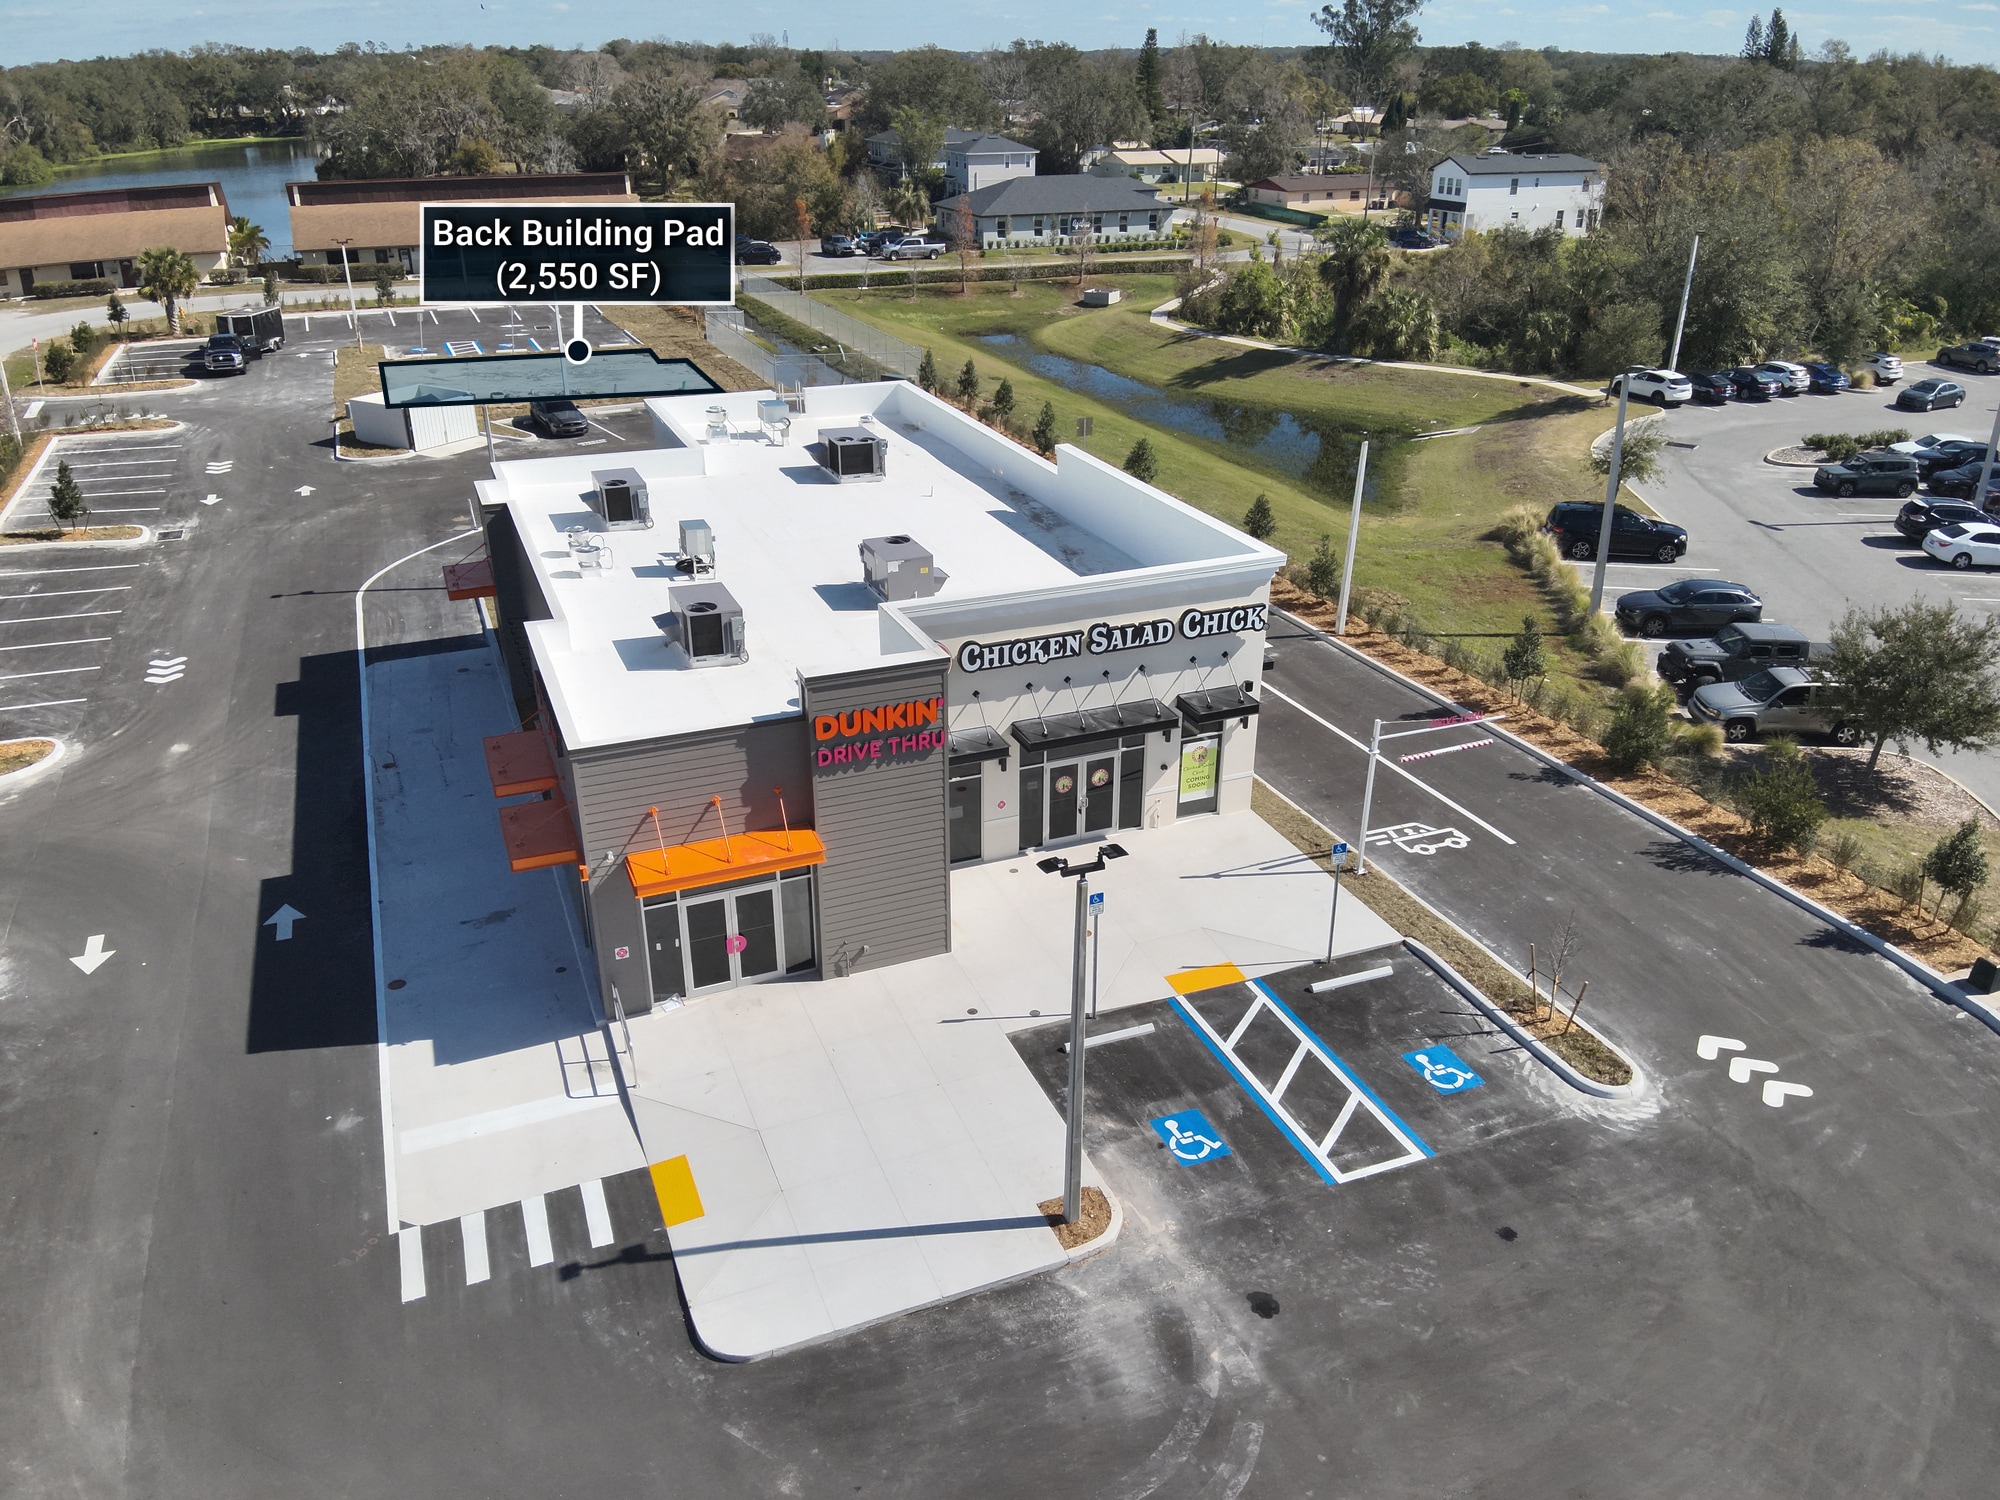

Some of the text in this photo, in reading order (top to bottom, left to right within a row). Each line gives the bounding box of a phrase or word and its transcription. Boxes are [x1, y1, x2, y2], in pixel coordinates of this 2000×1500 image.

[961, 605, 1267, 671] CHICKEN SALAD CHICK
[815, 697, 944, 741] DUNKIN'
[817, 731, 945, 767] DRIVE THRU
[1186, 774, 1210, 784] COMING
